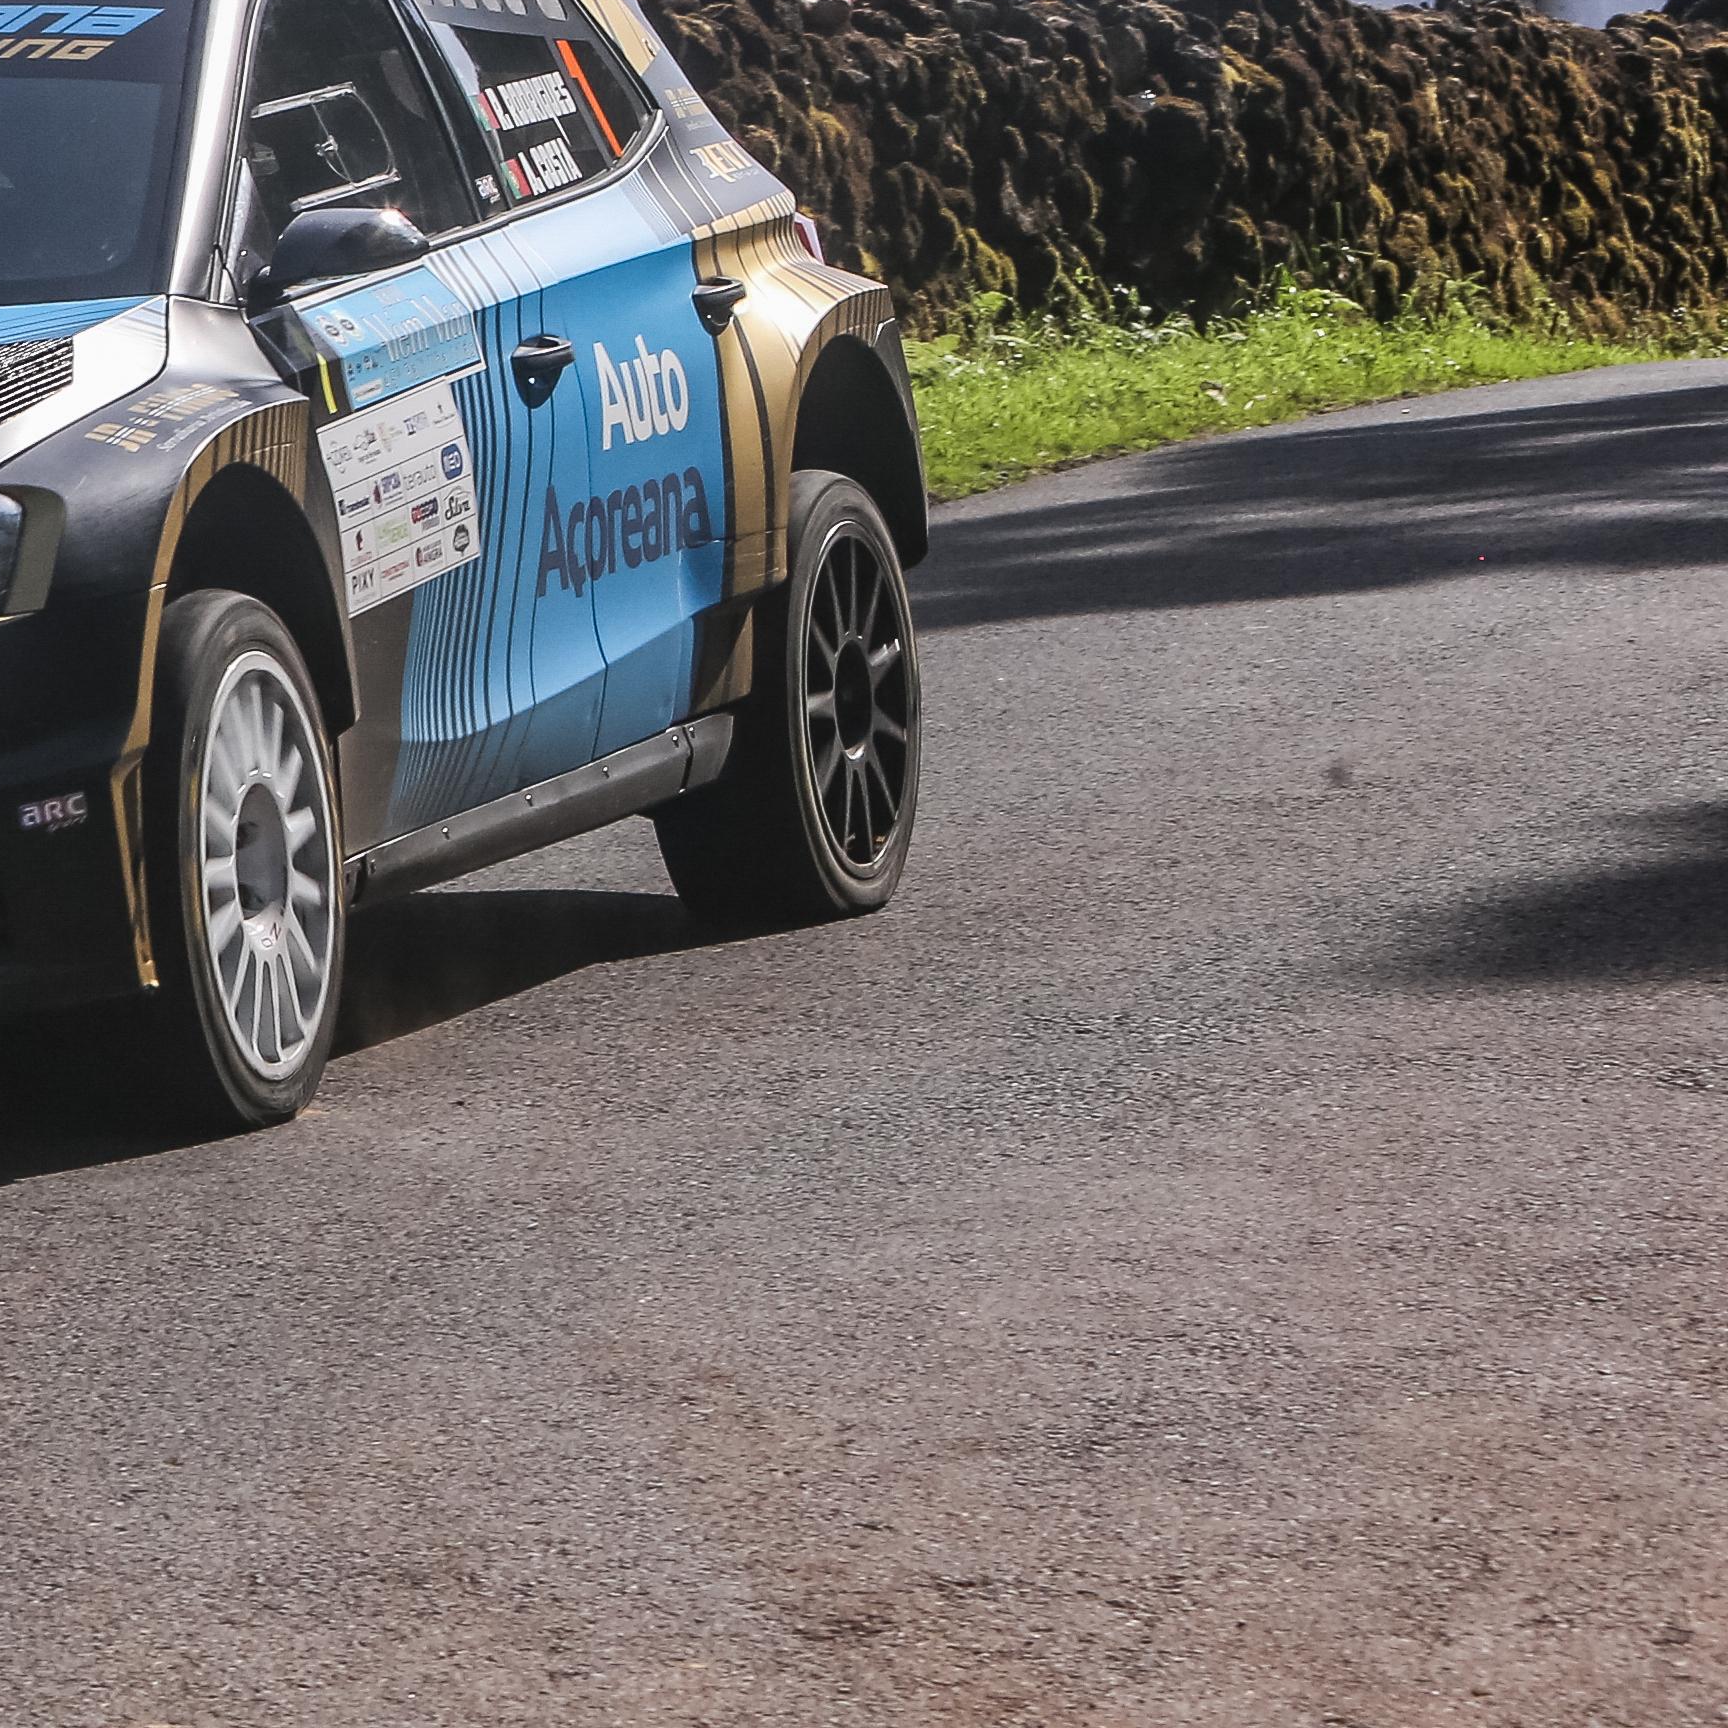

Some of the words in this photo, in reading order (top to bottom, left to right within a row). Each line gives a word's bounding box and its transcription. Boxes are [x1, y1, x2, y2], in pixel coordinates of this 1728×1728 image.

[496, 70, 577, 138] RODRIGUES
[528, 137, 583, 190] COSTA
[593, 334, 689, 451] Auto
[537, 466, 712, 598] Açoreana
[351, 567, 376, 596] PIXY
